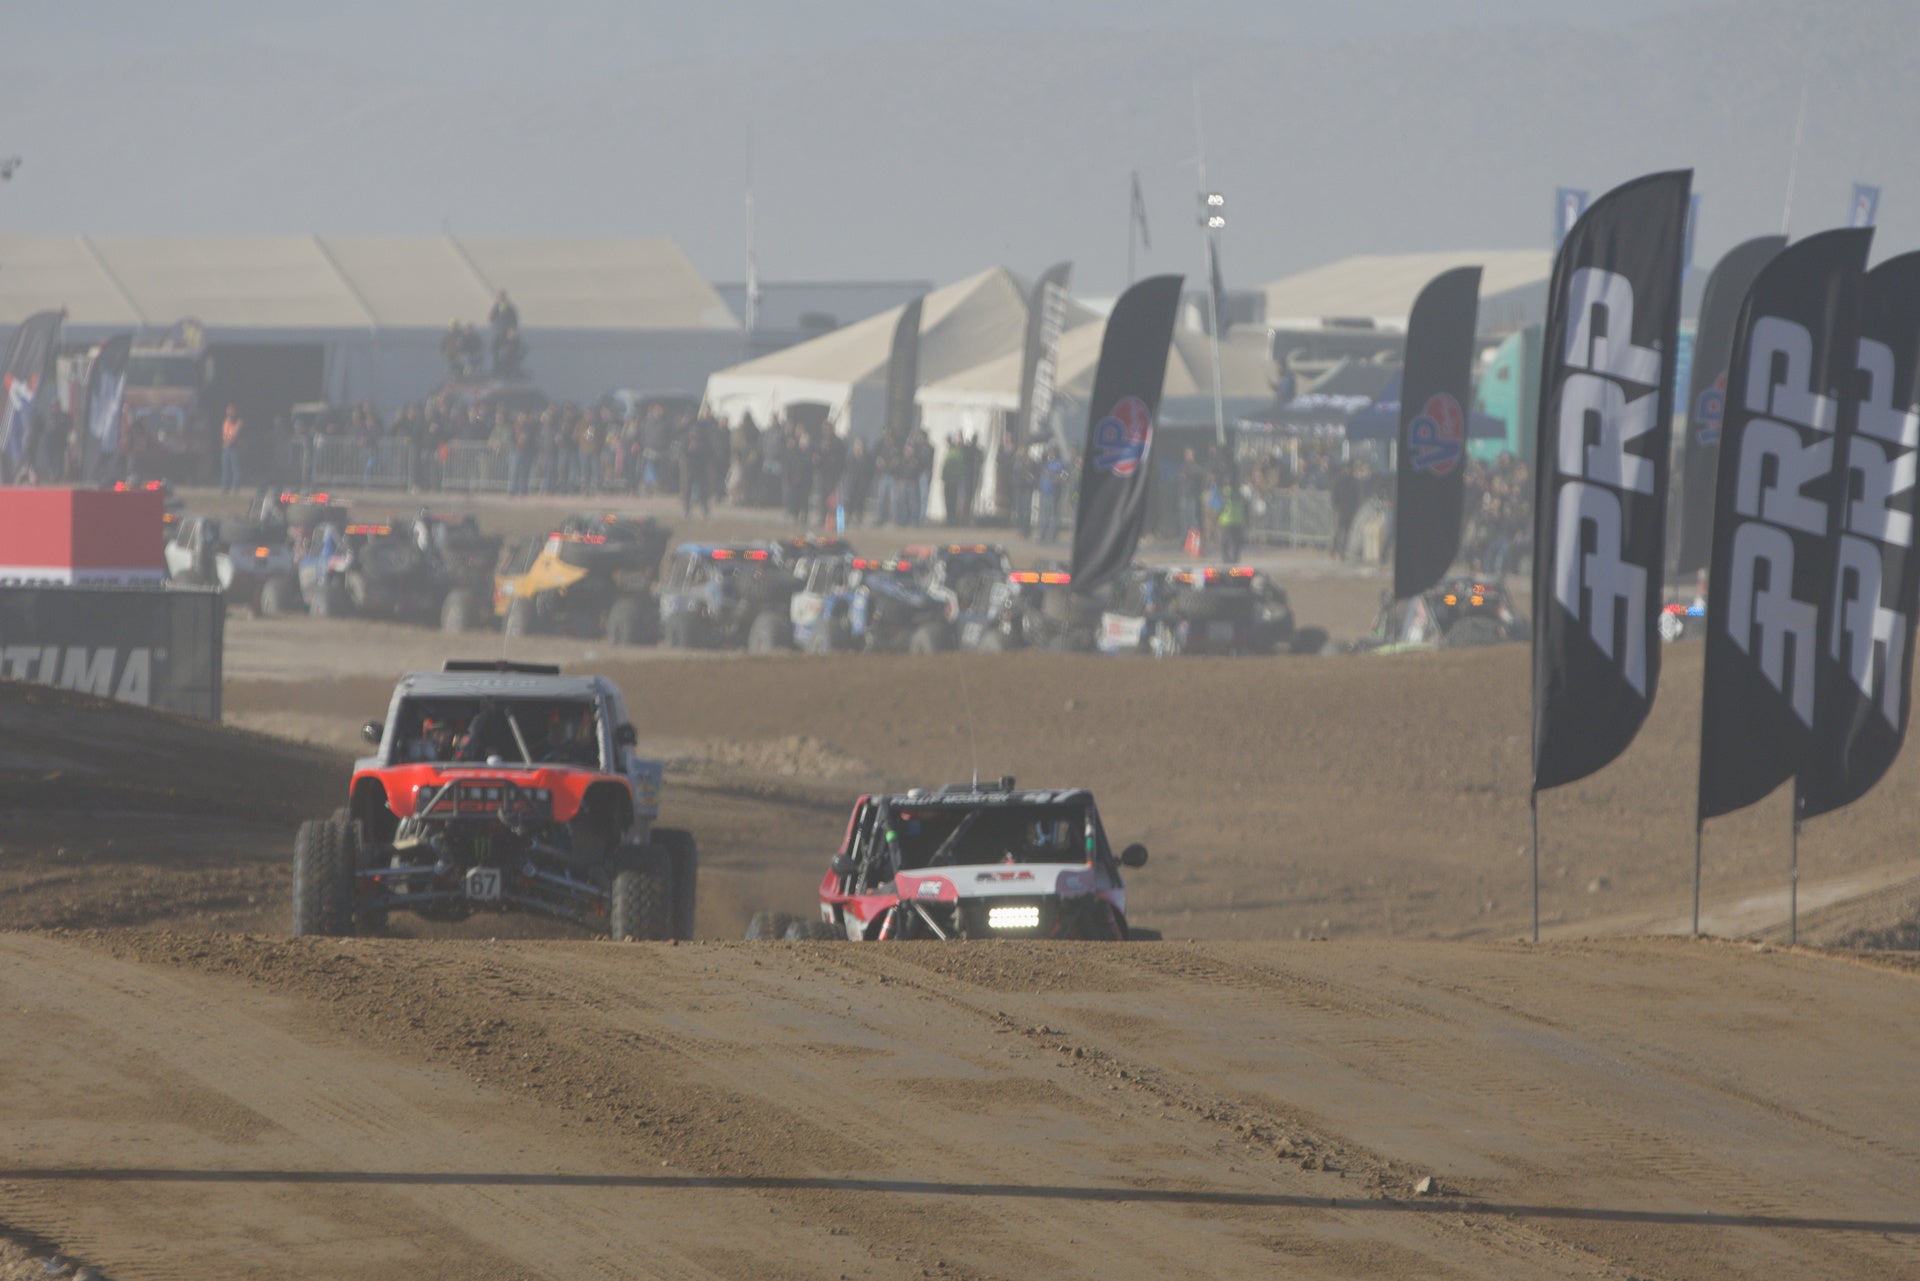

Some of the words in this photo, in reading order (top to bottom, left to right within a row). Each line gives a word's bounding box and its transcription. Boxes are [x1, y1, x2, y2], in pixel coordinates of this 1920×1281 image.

[1406, 414, 1461, 472] VP
[1556, 266, 1662, 699] PRP
[1727, 315, 1838, 729] PRP
[0, 643, 151, 707] TIMA
[470, 872, 497, 897] 67
